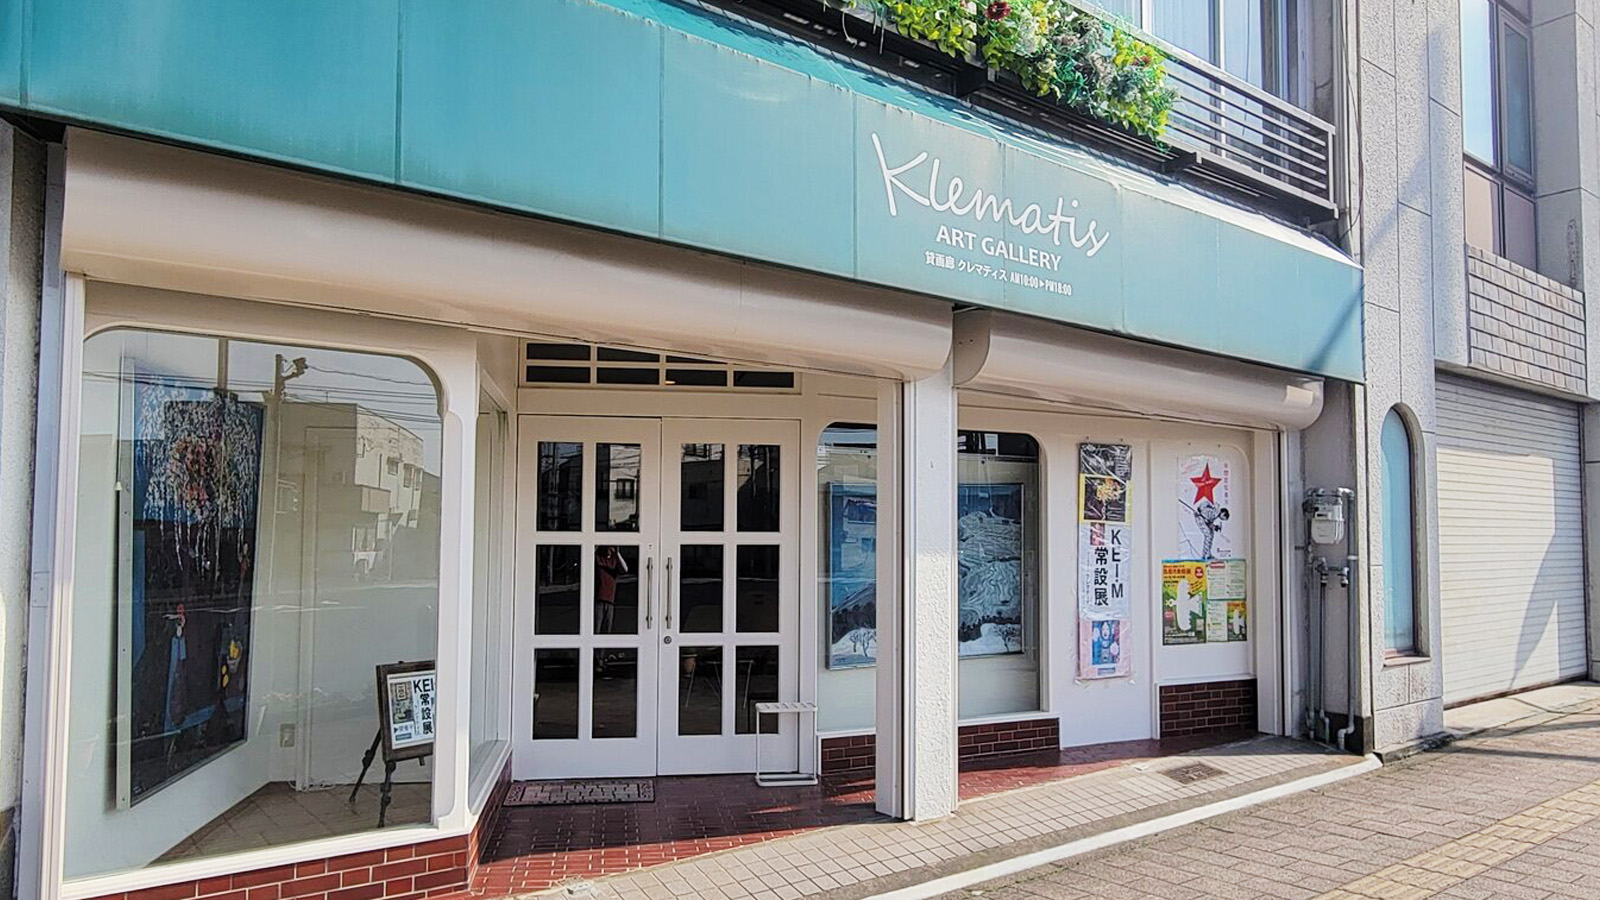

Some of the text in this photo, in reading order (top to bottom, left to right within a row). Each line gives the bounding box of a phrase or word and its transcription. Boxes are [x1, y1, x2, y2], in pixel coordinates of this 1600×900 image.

[872, 132, 1110, 257] Klematis
[936, 225, 1062, 271] ART GALLERY
[957, 260, 1008, 281] クレマティス
[1094, 546, 1108, 606] 常設展
